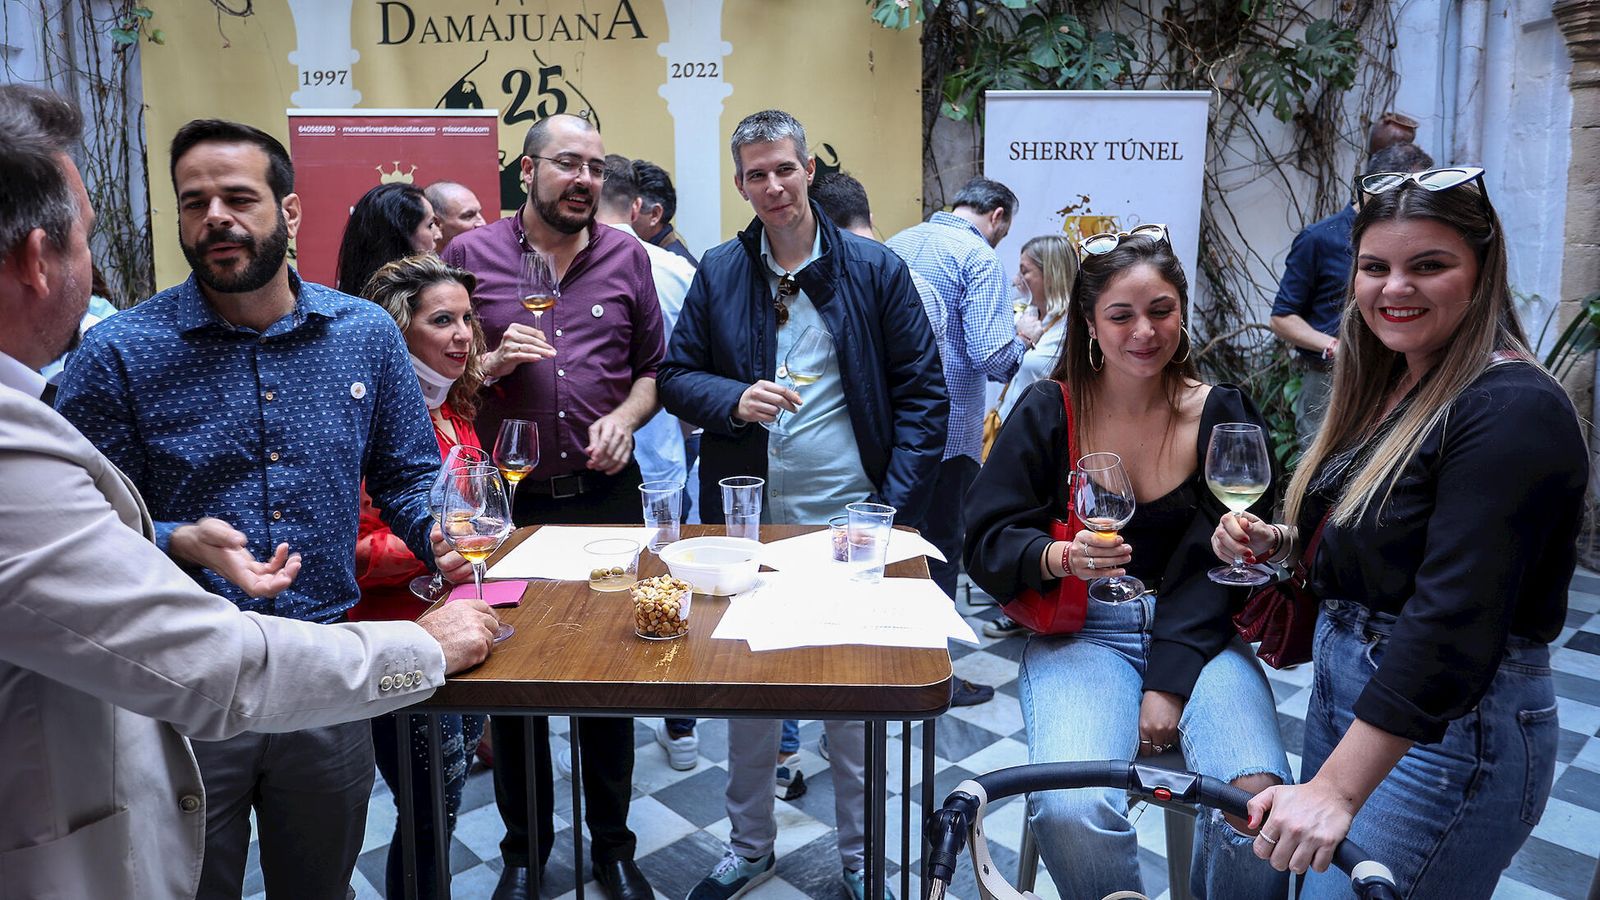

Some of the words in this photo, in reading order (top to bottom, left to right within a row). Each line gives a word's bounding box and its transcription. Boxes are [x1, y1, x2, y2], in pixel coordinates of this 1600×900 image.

[301, 70, 348, 86] 1997
[671, 62, 719, 78] 2022
[501, 65, 568, 126] 25
[1009, 141, 1098, 161] SHERRY
[1104, 137, 1183, 161] TÚNEL
